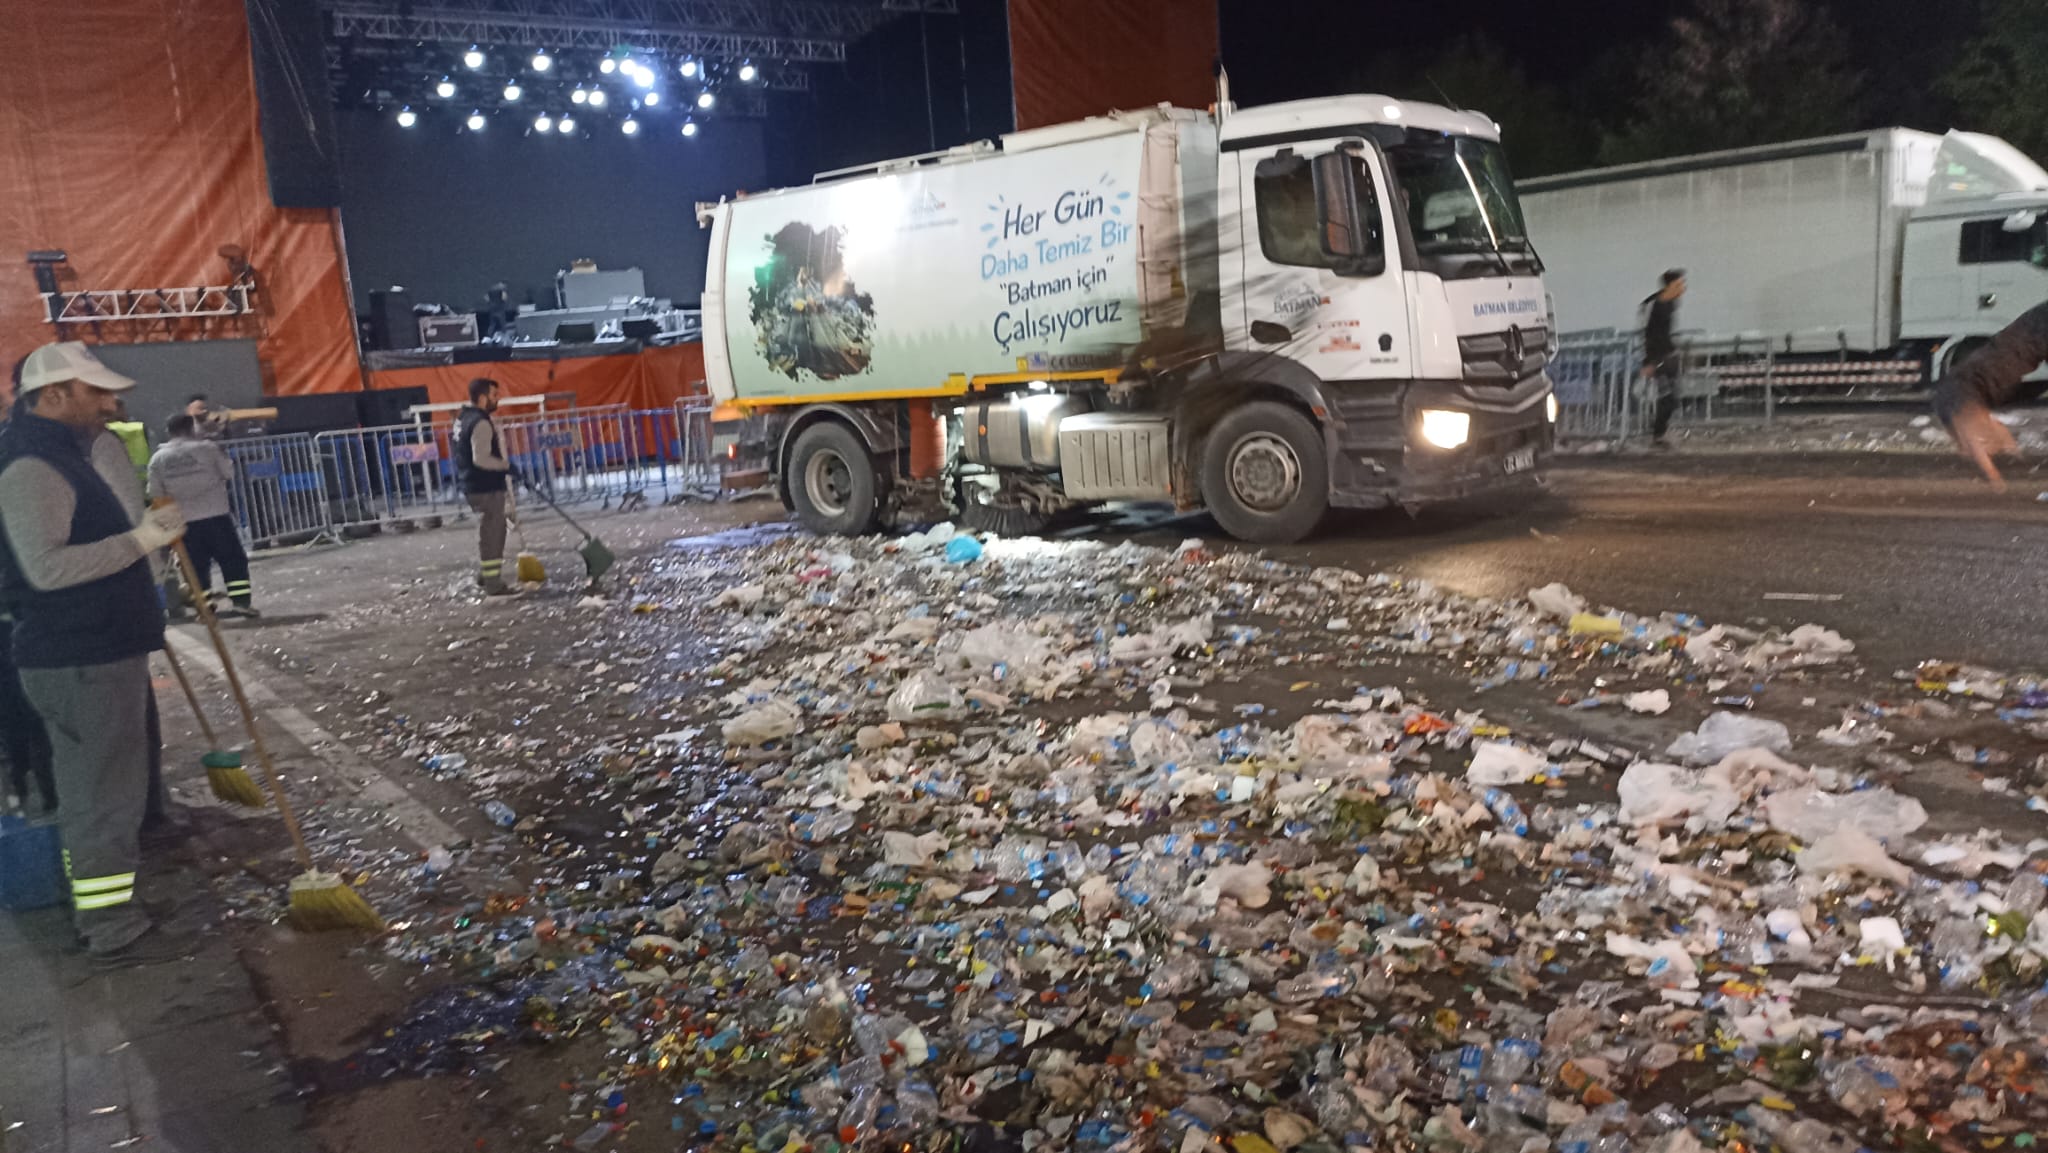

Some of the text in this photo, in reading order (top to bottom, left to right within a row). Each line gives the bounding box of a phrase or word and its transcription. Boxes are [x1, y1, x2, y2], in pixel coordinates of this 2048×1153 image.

[1003, 190, 1104, 239] Her Gün
[981, 219, 1132, 280] Daha Temiz Bir
[994, 300, 1122, 356] Çalışıyoruz
[1473, 301, 1506, 317] BATMAN
